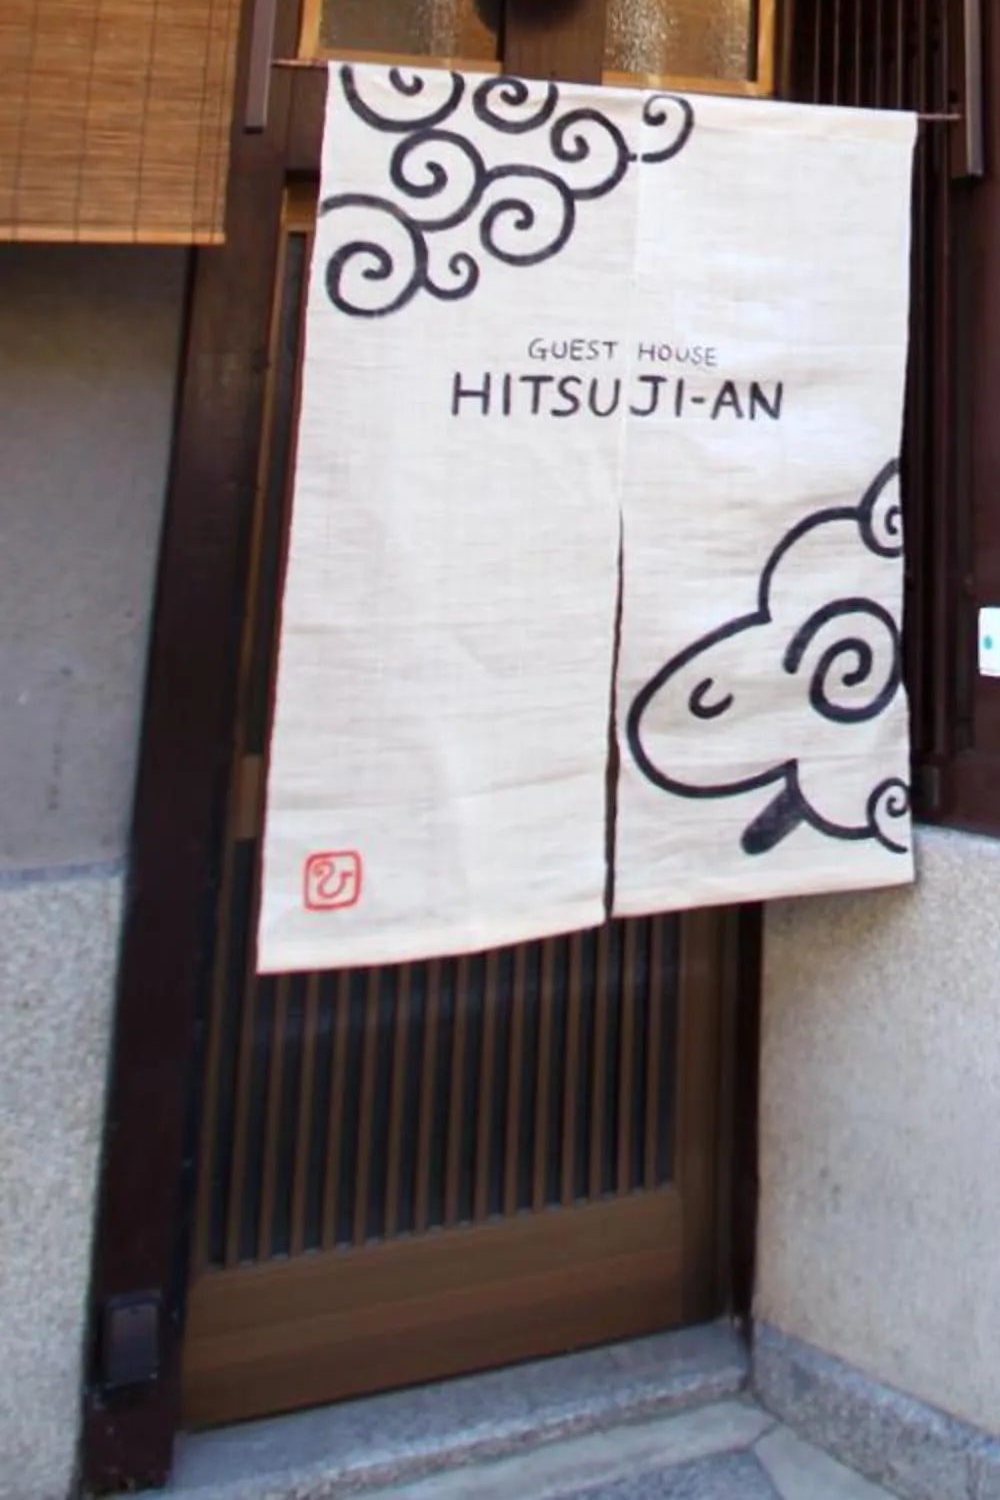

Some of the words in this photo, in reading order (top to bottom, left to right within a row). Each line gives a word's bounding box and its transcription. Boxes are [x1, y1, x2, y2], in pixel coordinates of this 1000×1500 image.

[527, 337, 619, 362] GUEST
[637, 342, 719, 368] HOUSE
[451, 371, 784, 421] HITSUJI-AN
